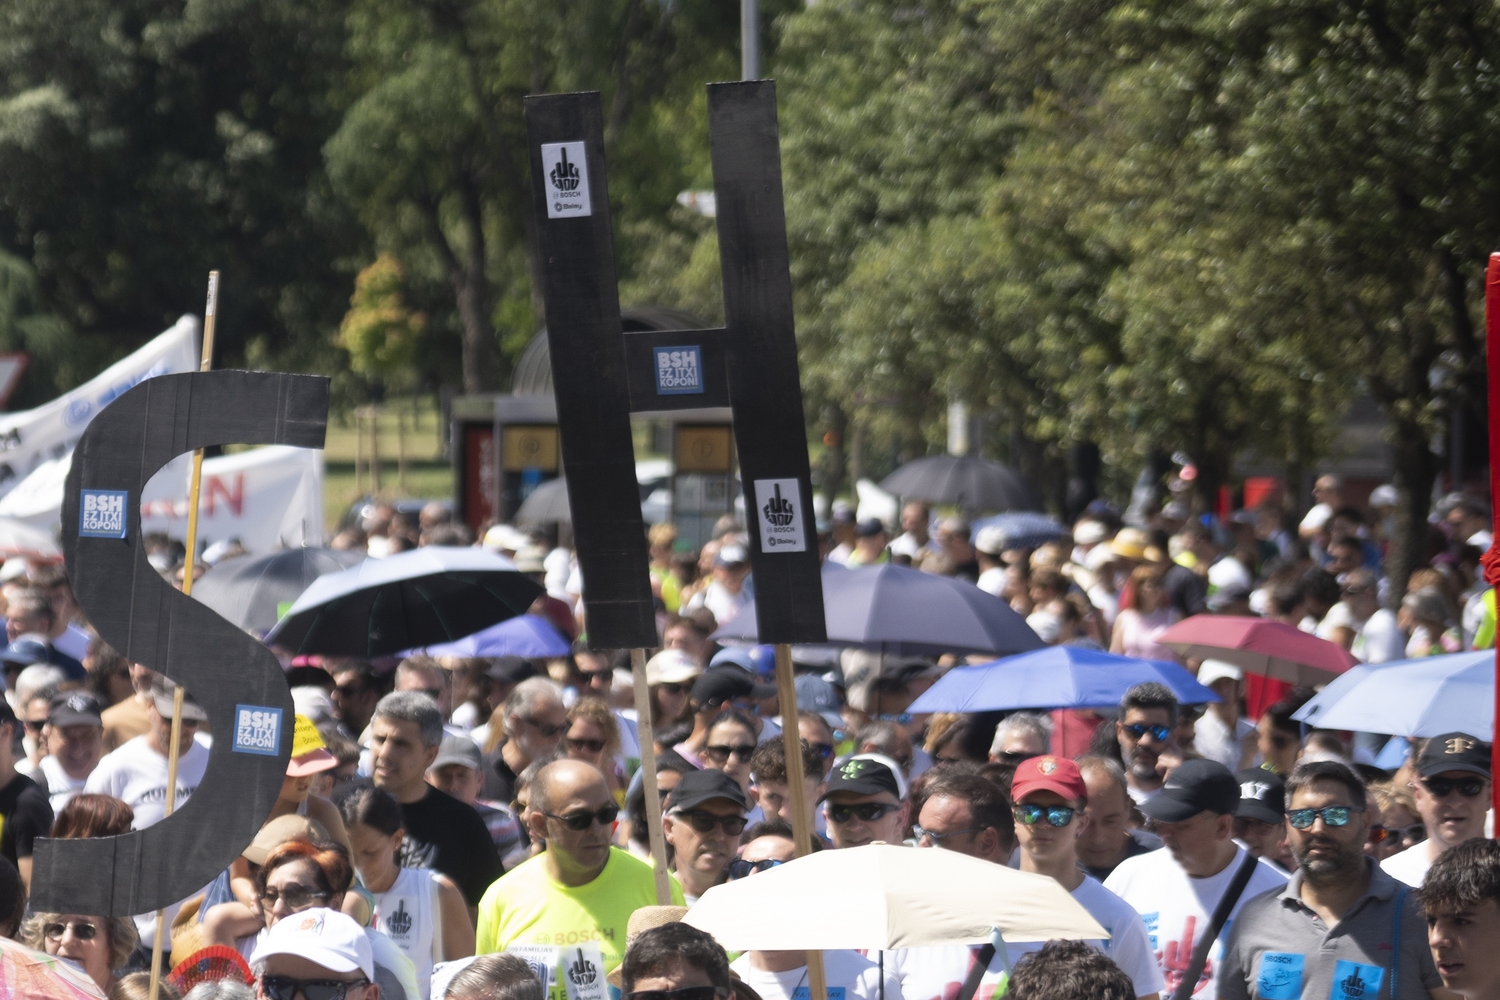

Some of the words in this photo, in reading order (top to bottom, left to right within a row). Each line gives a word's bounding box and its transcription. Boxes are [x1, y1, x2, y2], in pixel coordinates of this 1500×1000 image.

[657, 351, 697, 368] BSH
[659, 368, 673, 379] EZ
[675, 367, 698, 378] ITXI
[84, 494, 123, 512] BSH
[83, 510, 98, 521] EZ
[100, 511, 122, 522] ITXI
[238, 710, 278, 729] BSH
[237, 726, 252, 737] EZ
[253, 727, 276, 739] ITXI
[554, 928, 615, 945] BOSCH
